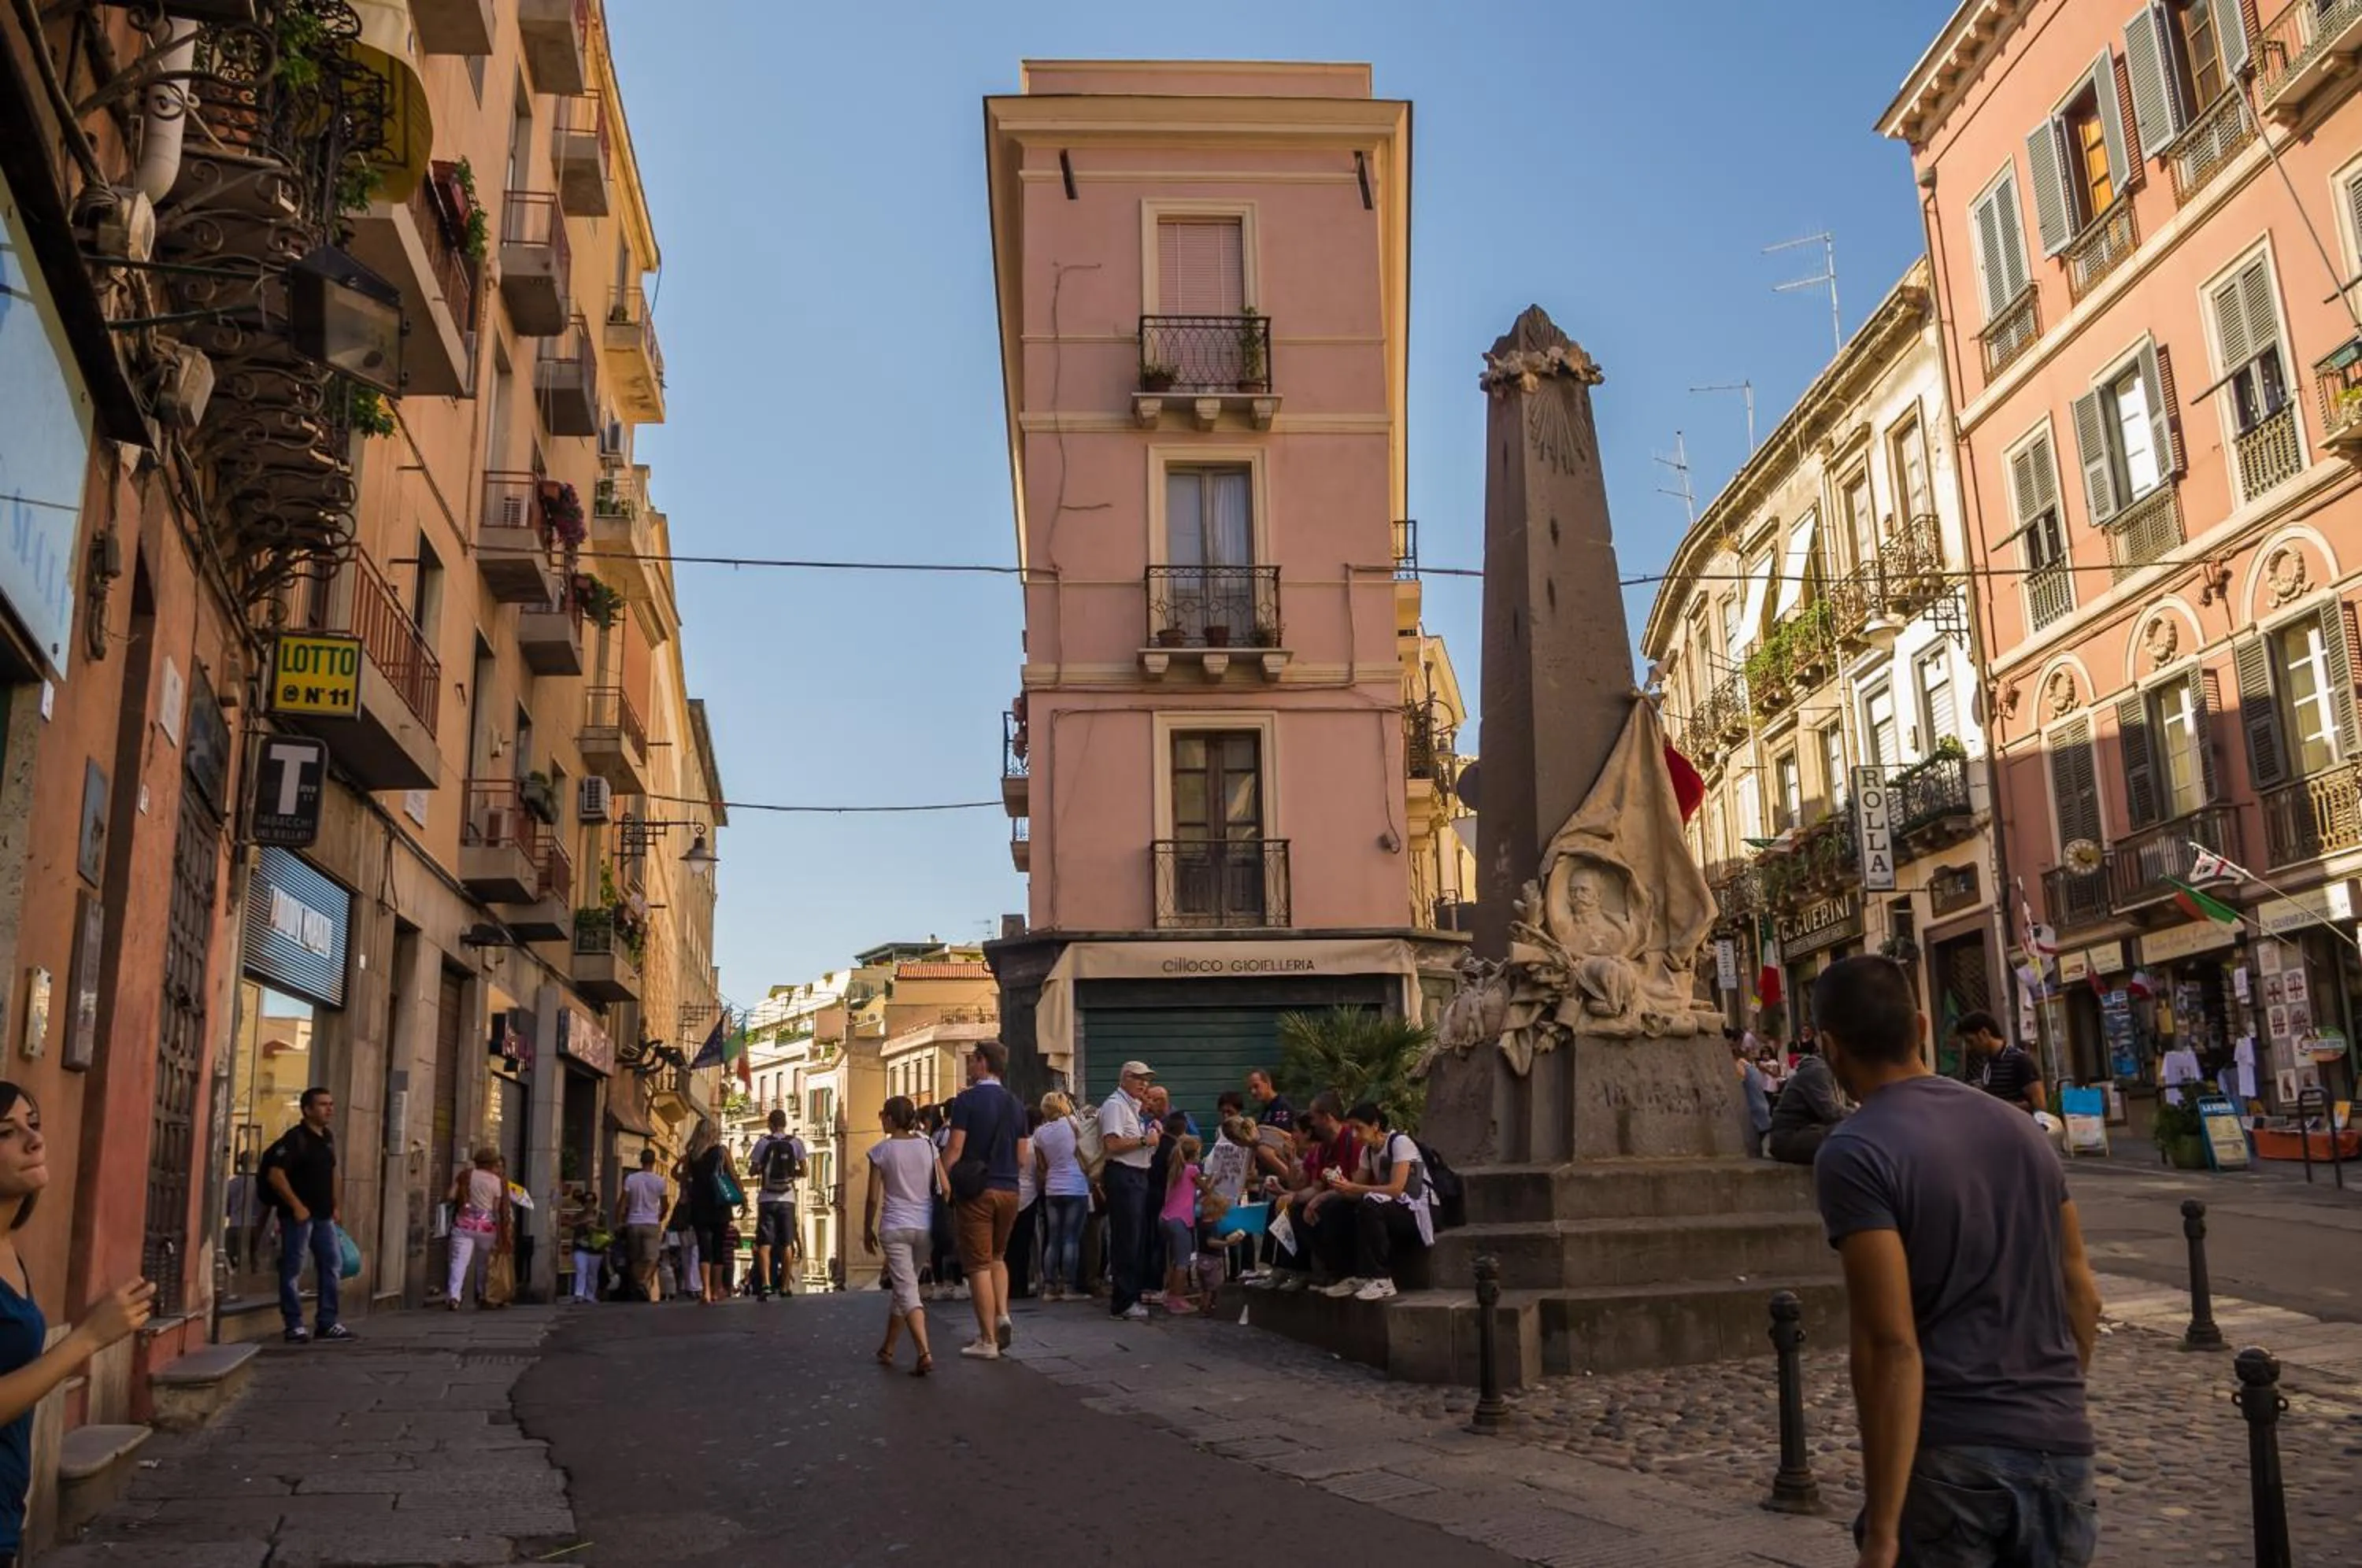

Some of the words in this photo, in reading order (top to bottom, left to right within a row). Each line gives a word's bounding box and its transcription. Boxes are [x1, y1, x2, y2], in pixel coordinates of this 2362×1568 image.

[281, 642, 355, 677] LOTTO
[329, 689, 350, 705] 11
[269, 743, 320, 815] T
[1861, 768, 1889, 874] ROLLA
[1794, 894, 1850, 937] GUERINI
[1231, 959, 1316, 972] GIOIELLERIA
